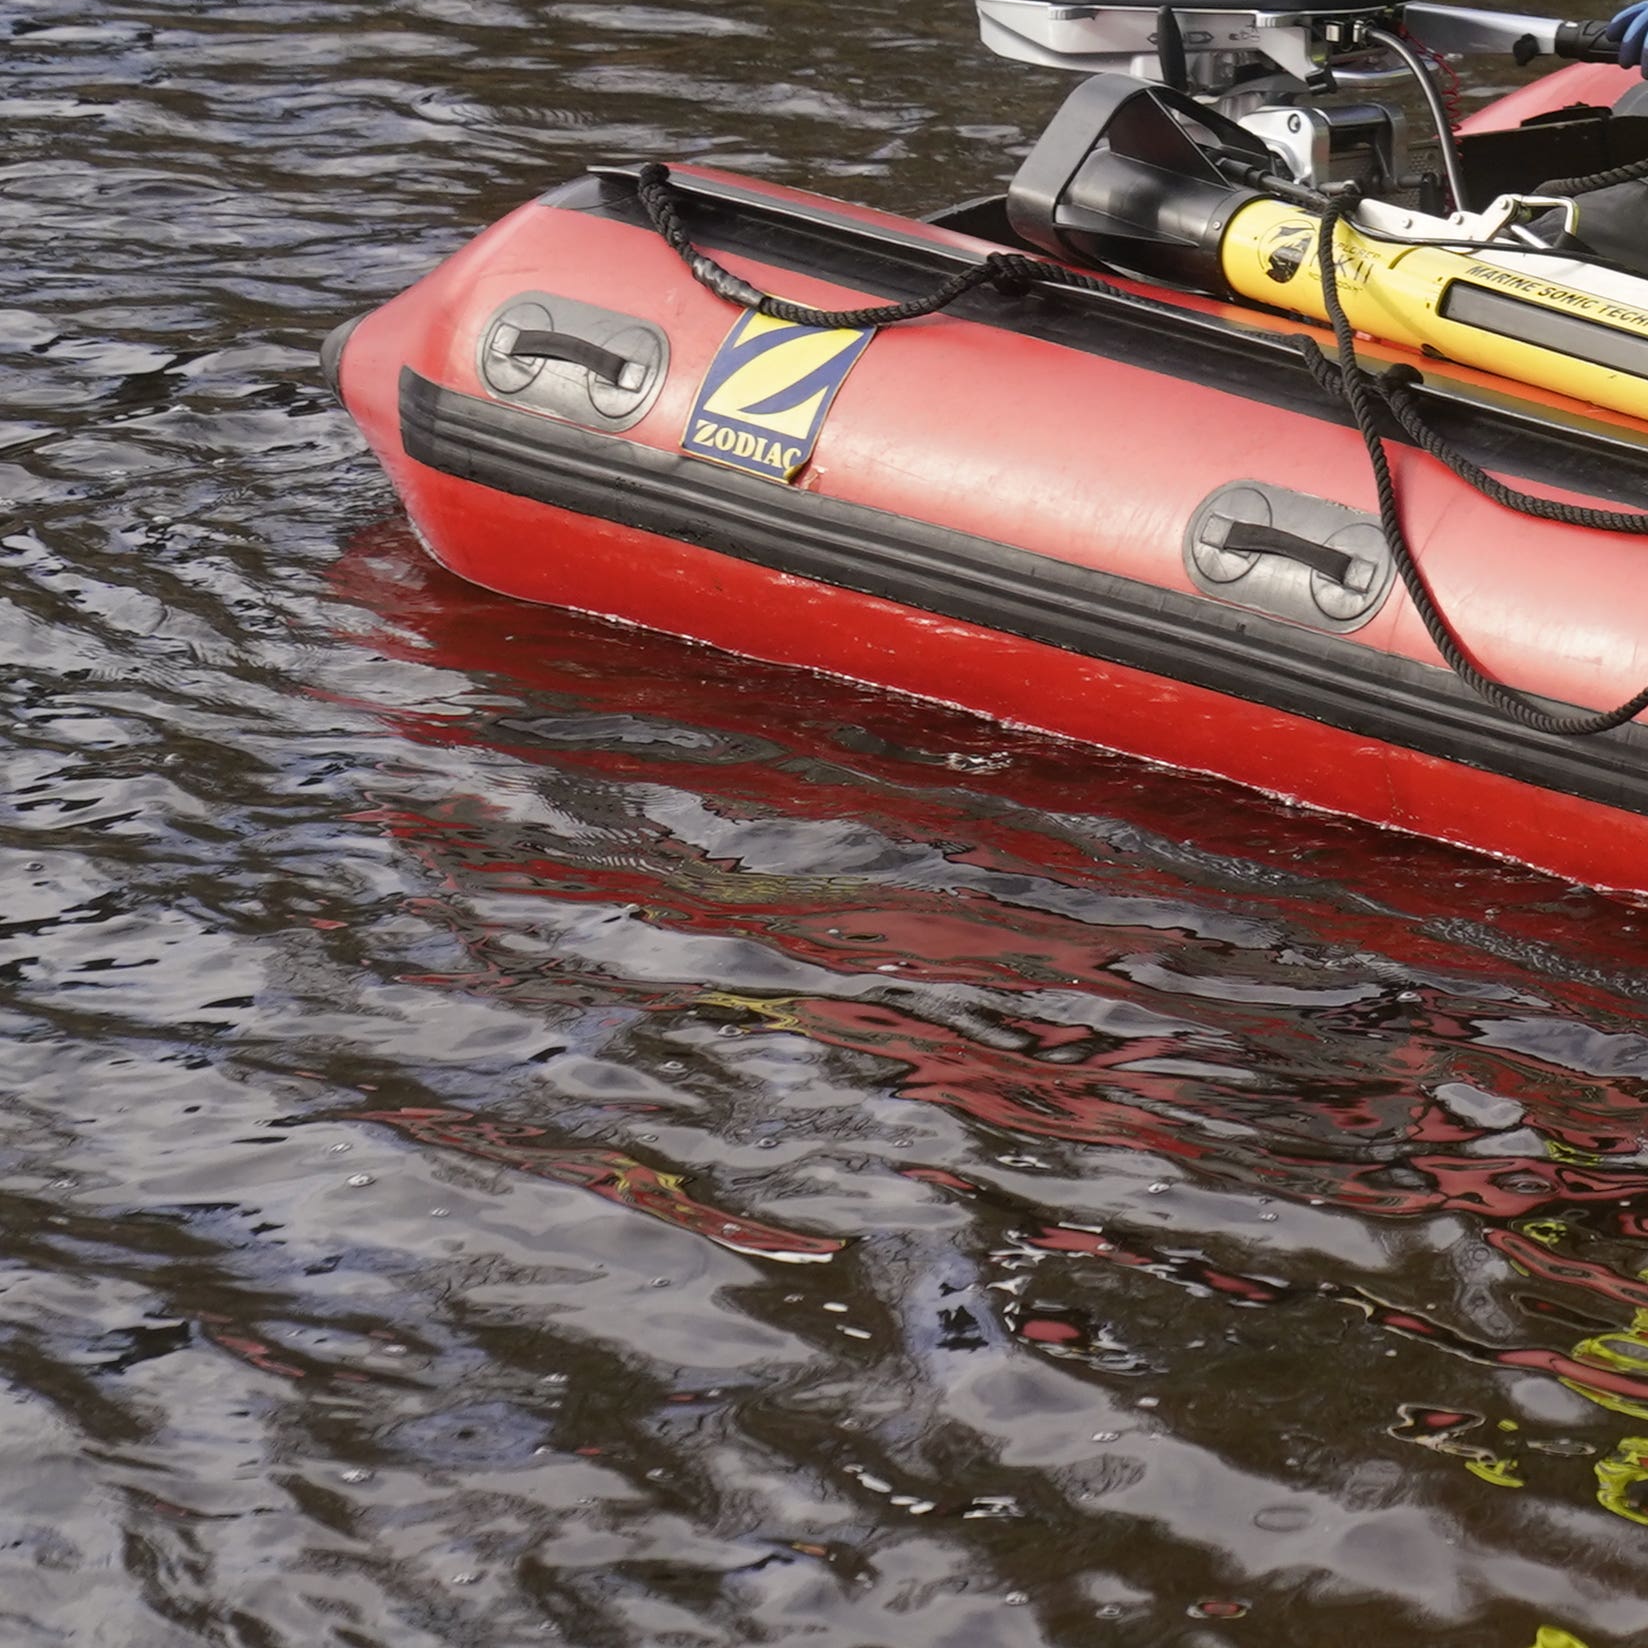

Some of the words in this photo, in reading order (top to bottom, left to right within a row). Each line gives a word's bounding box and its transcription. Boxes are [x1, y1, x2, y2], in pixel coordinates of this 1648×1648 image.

[1465, 264, 1540, 293] MARINE
[1537, 286, 1600, 310] SONIC
[692, 419, 802, 471] ZODIAC
